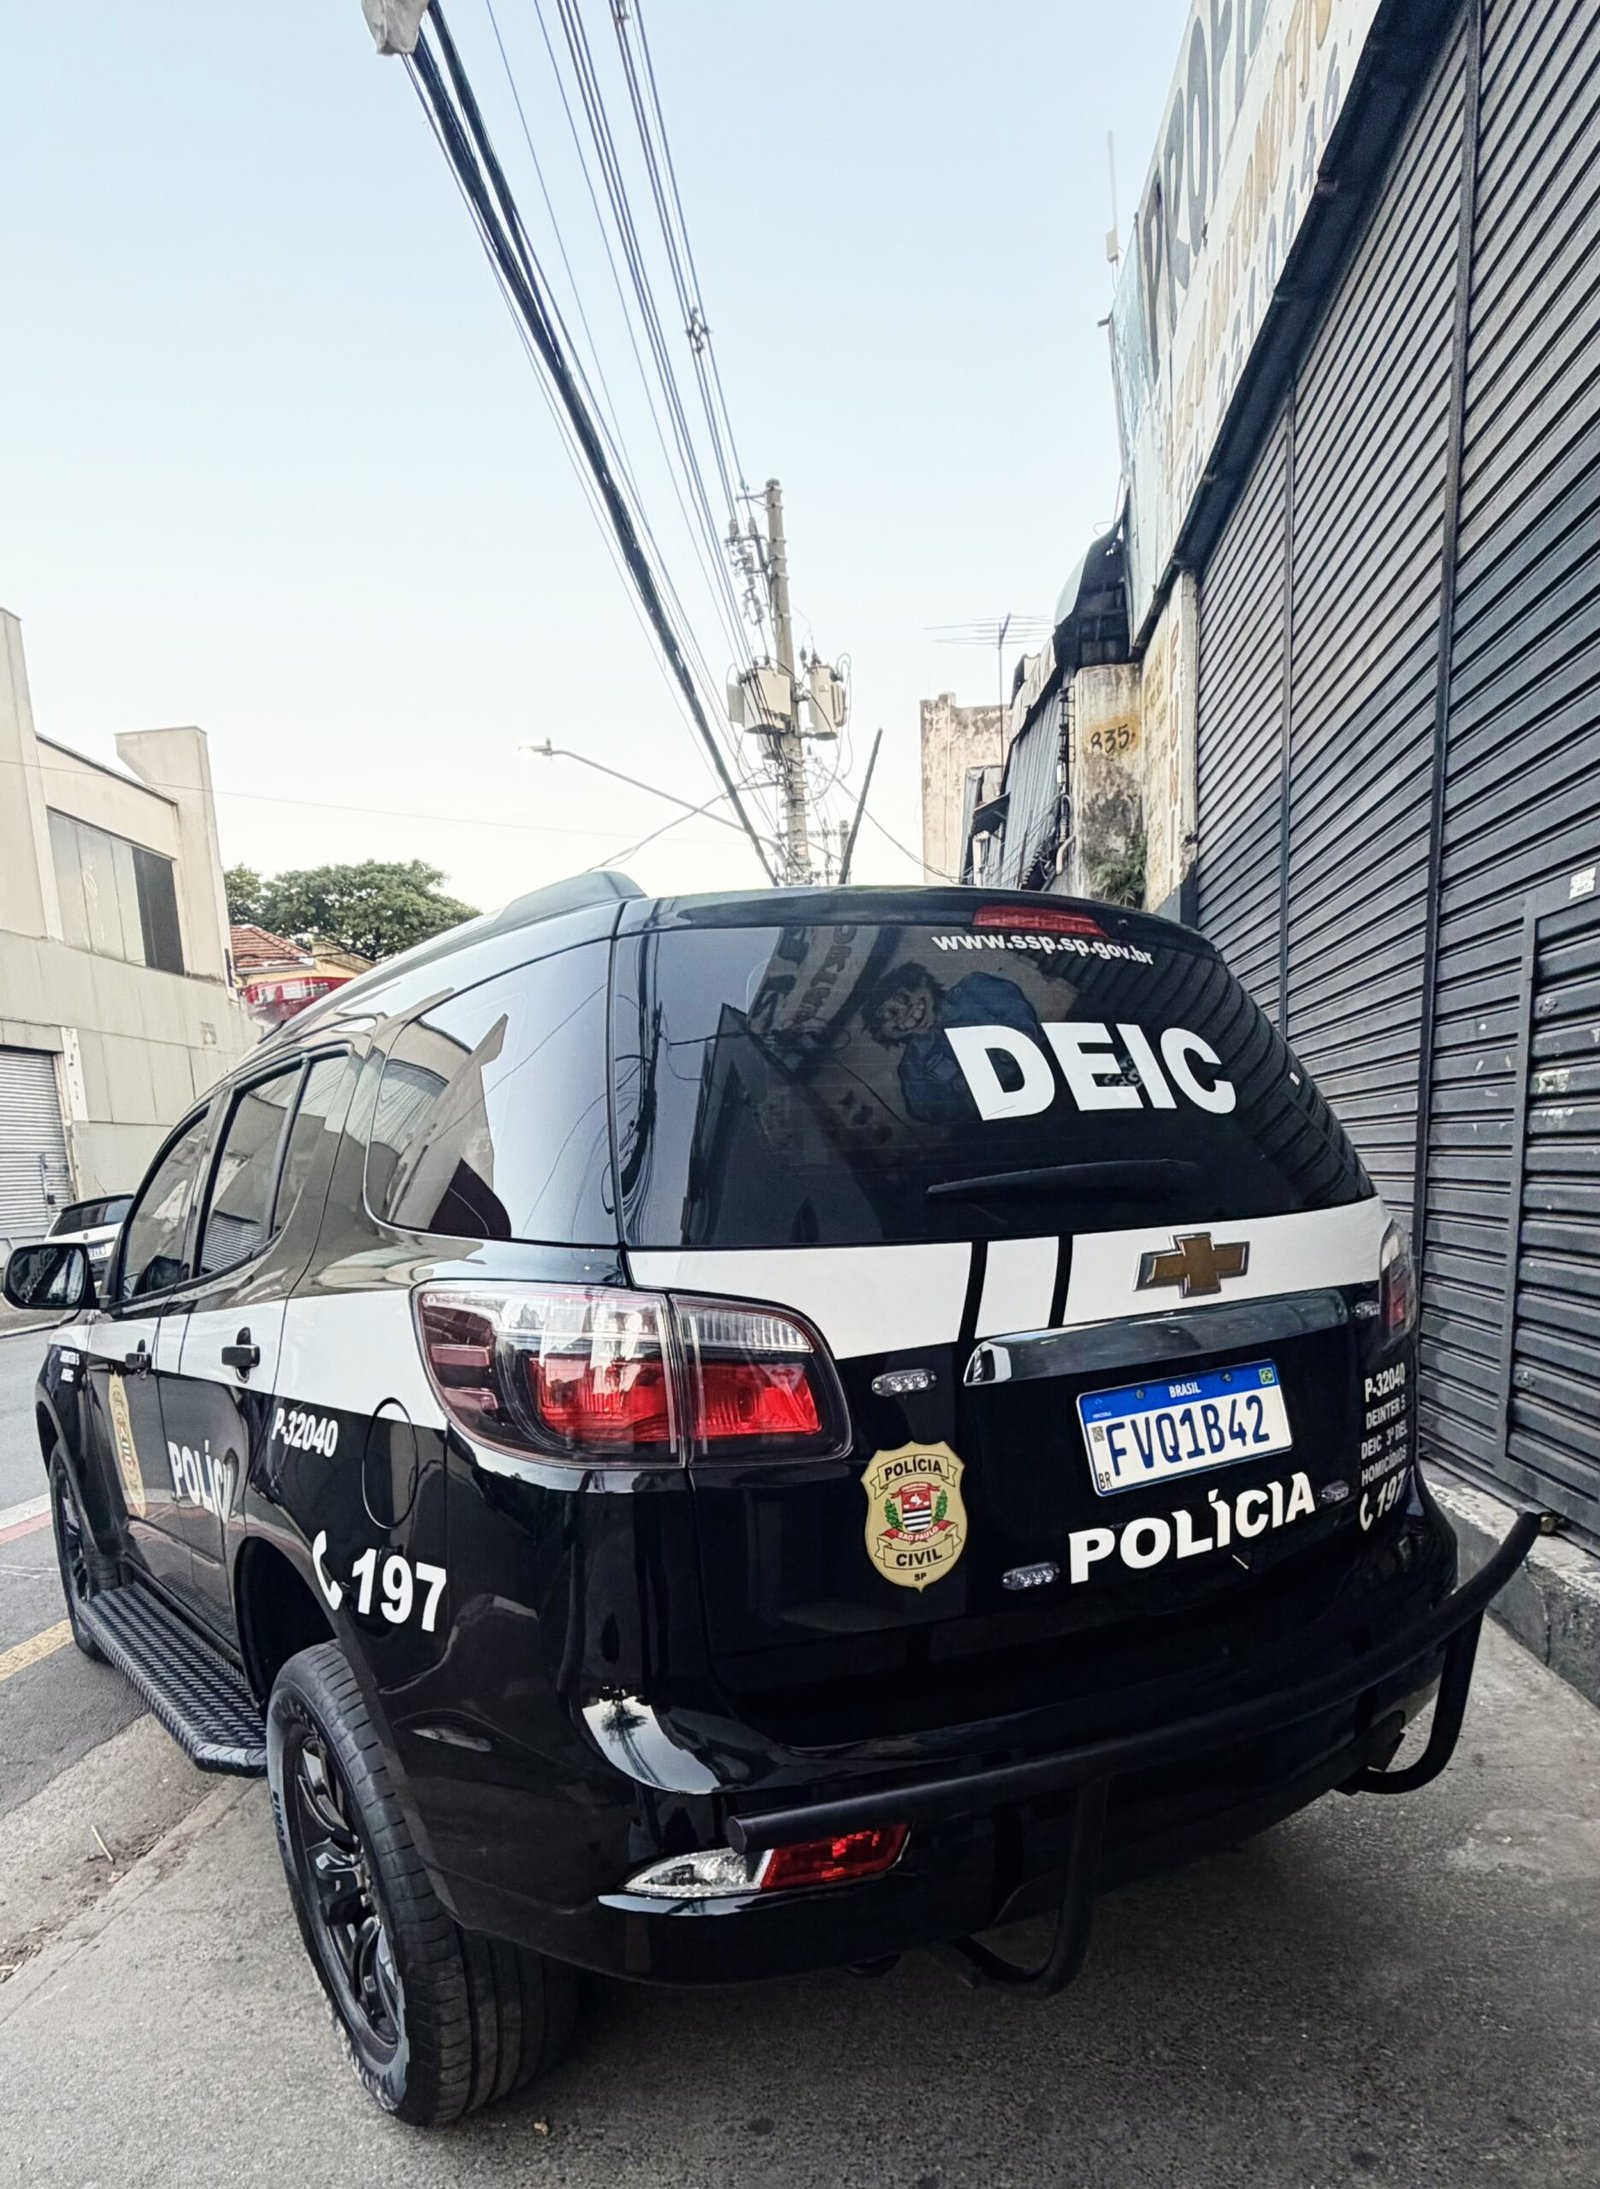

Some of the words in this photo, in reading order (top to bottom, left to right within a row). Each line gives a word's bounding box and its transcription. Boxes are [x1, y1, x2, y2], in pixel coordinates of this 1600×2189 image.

[932, 933, 1154, 965] www.ssp.sp.gov.br
[944, 1022, 1236, 1121] DEIC
[1168, 1382, 1202, 1398] BRASIL
[1364, 1362, 1406, 1403] P-32040
[271, 1407, 339, 1458] P-32040
[1105, 1395, 1270, 1476] FVQ1B42
[1361, 1434, 1382, 1460] DEIC
[884, 1457, 942, 1481] POLÍCIA
[1098, 1472, 1113, 1489] BR
[1377, 1467, 1408, 1518] 197
[1069, 1471, 1316, 1584] POLÍCIA
[896, 1548, 943, 1567] CIVIL
[351, 1547, 447, 1633] 197
[914, 1572, 927, 1582] SP
